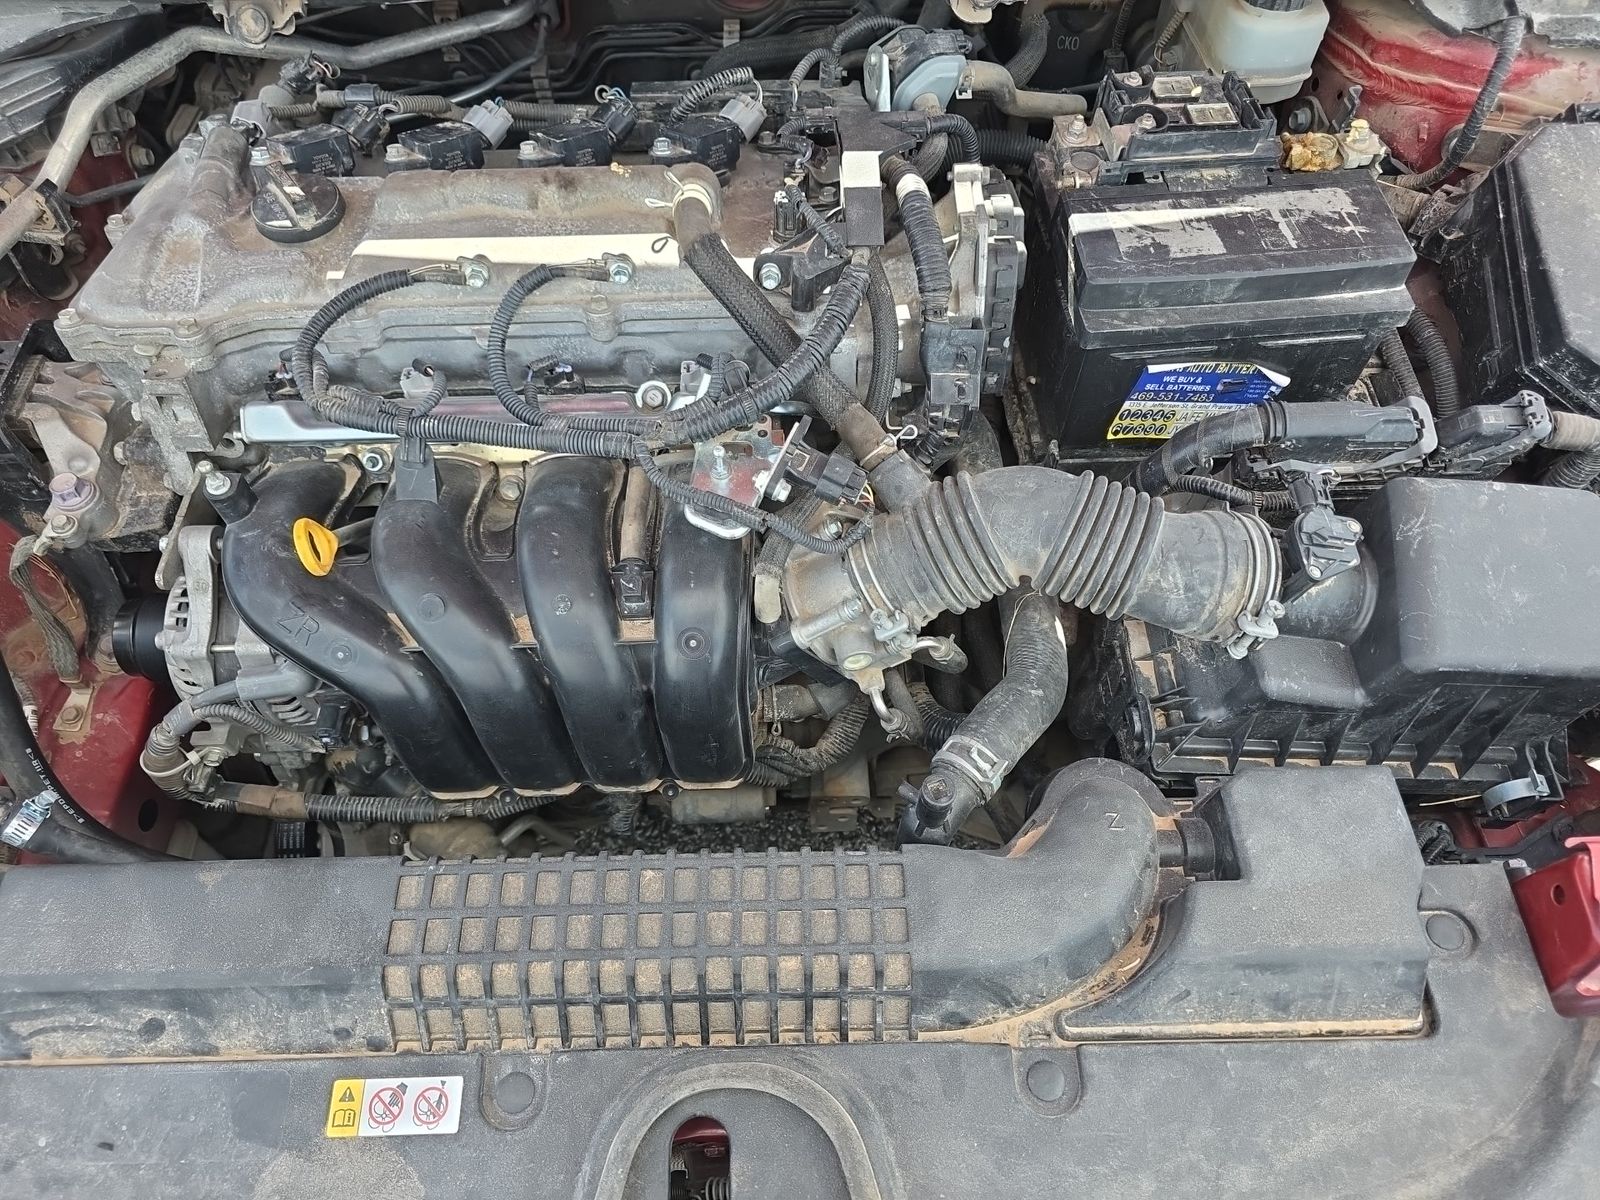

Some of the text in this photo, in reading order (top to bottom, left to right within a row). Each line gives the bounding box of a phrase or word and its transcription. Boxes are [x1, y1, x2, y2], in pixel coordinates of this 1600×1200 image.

[1178, 376, 1196, 384] BUY
[1130, 391, 1215, 402] 469-531-7483
[276, 601, 320, 647] ZR
